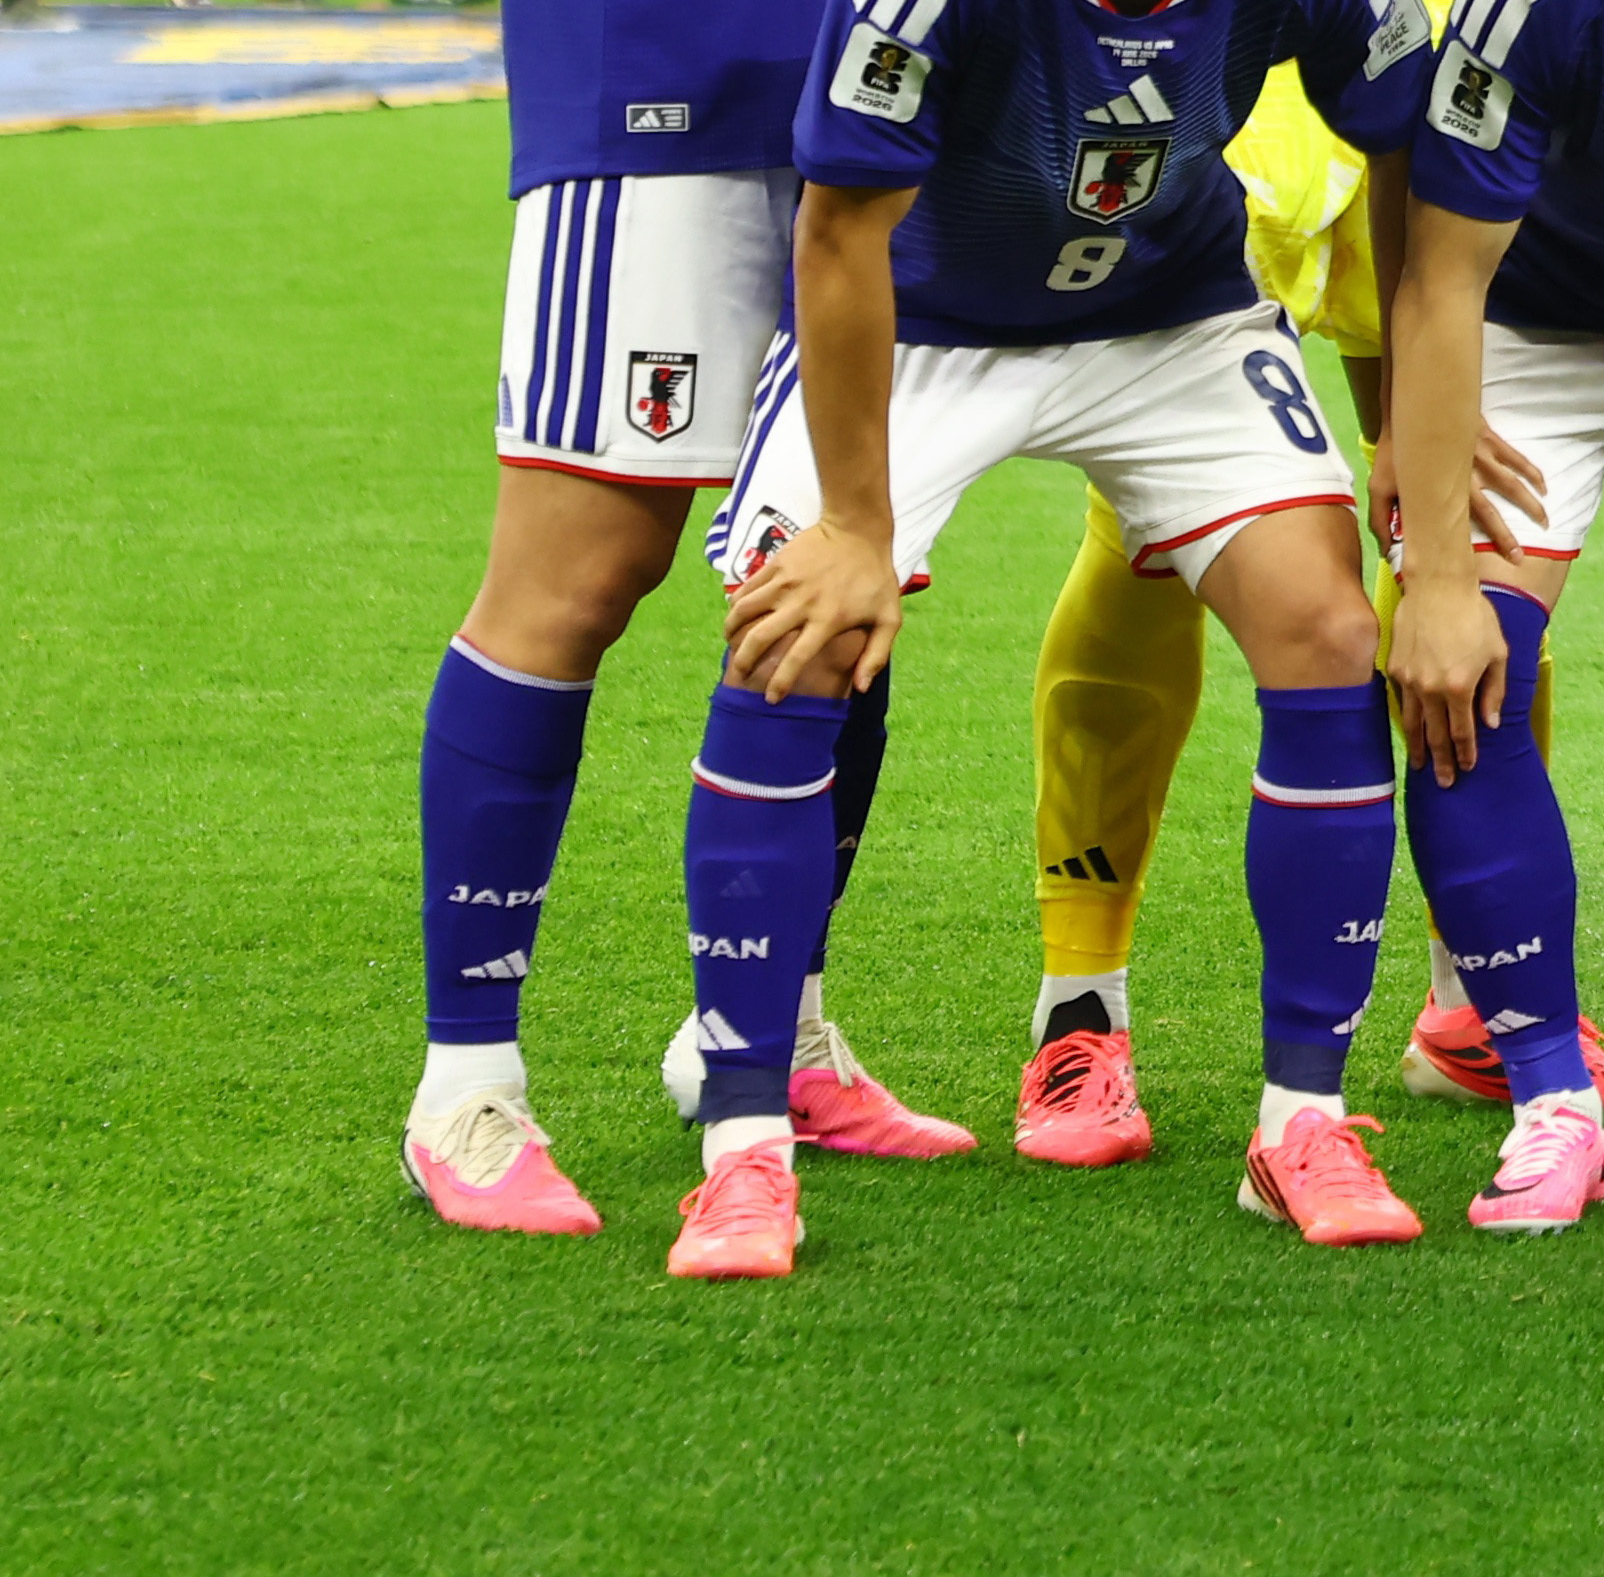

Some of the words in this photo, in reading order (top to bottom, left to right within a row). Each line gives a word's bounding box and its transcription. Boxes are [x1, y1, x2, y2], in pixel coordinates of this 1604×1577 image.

[1380, 21, 1409, 54] PEACE
[851, 94, 893, 113] 2026
[1459, 100, 1478, 116] FIFA
[1441, 115, 1479, 139] 2026
[1045, 234, 1127, 293] 8
[644, 353, 684, 363] JAPAN
[1242, 348, 1329, 455] 8
[447, 883, 549, 909] JAPA
[688, 933, 769, 960] PAN
[1450, 936, 1543, 972] APAN
